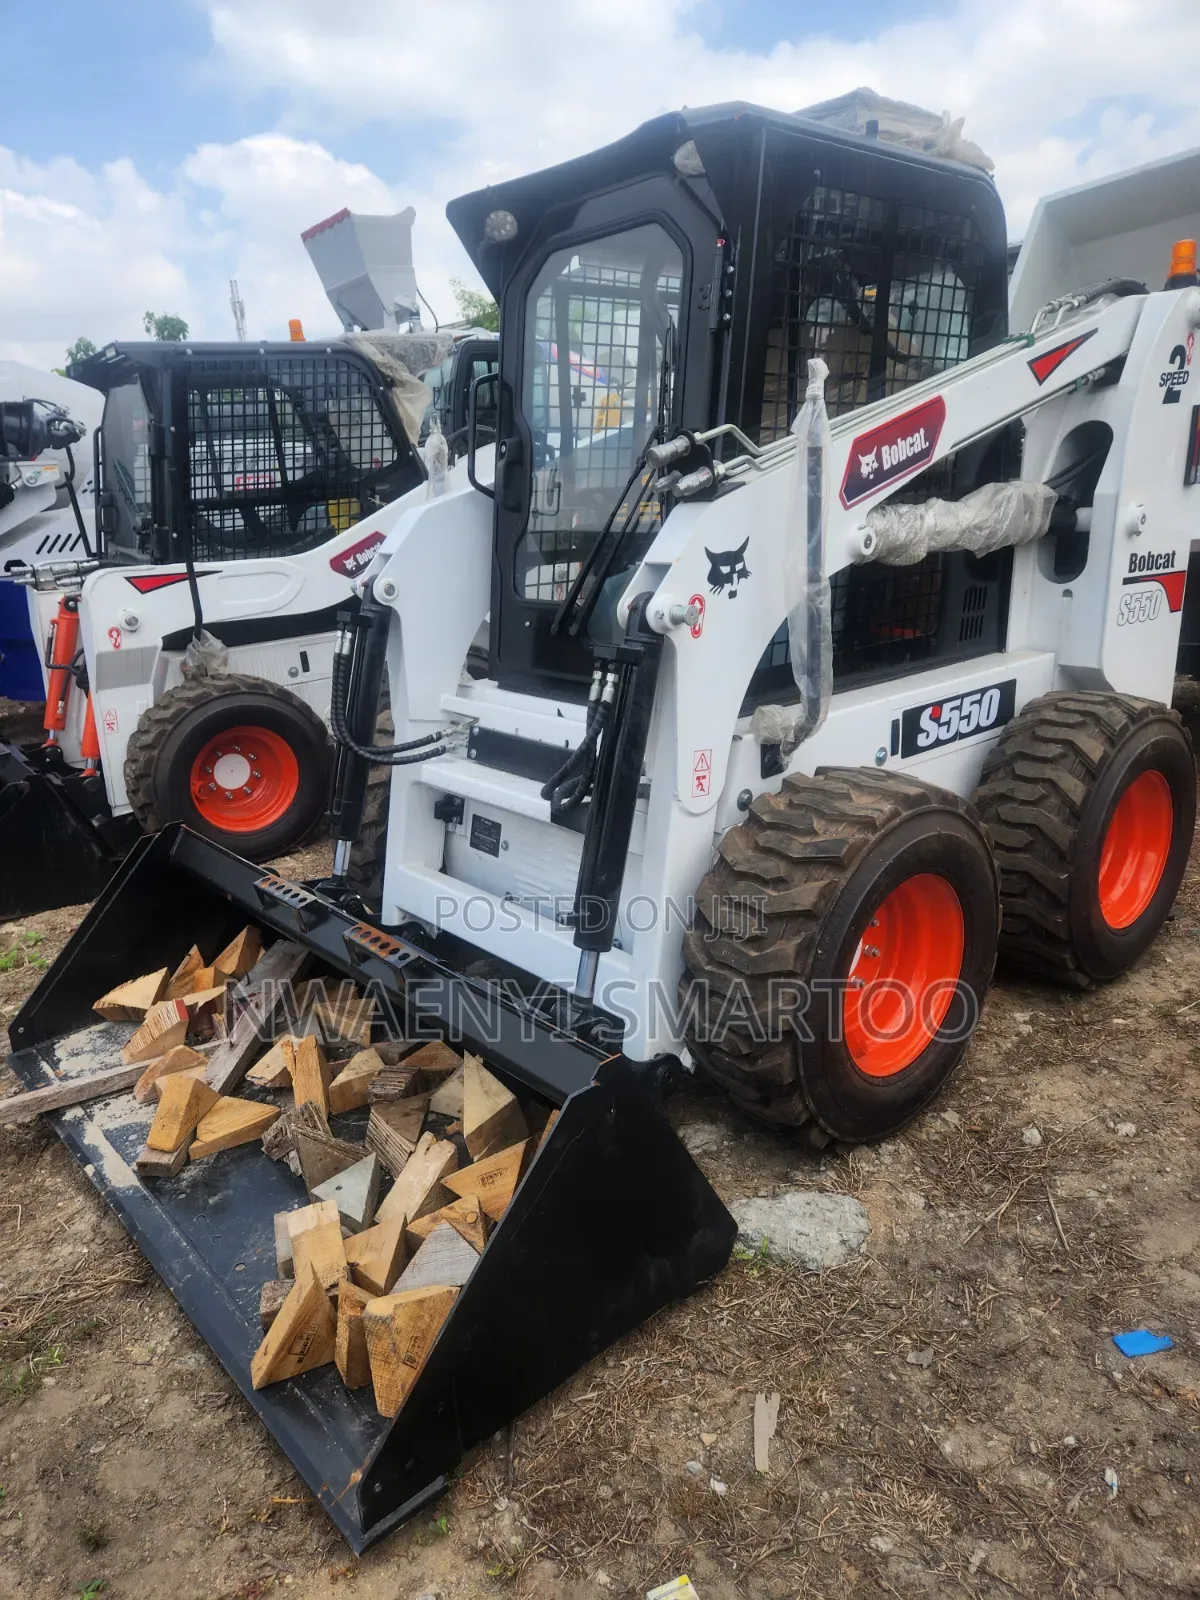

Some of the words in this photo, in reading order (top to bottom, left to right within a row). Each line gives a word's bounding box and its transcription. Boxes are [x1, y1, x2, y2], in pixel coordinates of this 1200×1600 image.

[1159, 370, 1190, 388] SPEED
[1162, 344, 1187, 404] 2
[1128, 550, 1176, 573] Bobcat
[1117, 589, 1163, 626] S550
[917, 688, 1001, 747] S550
